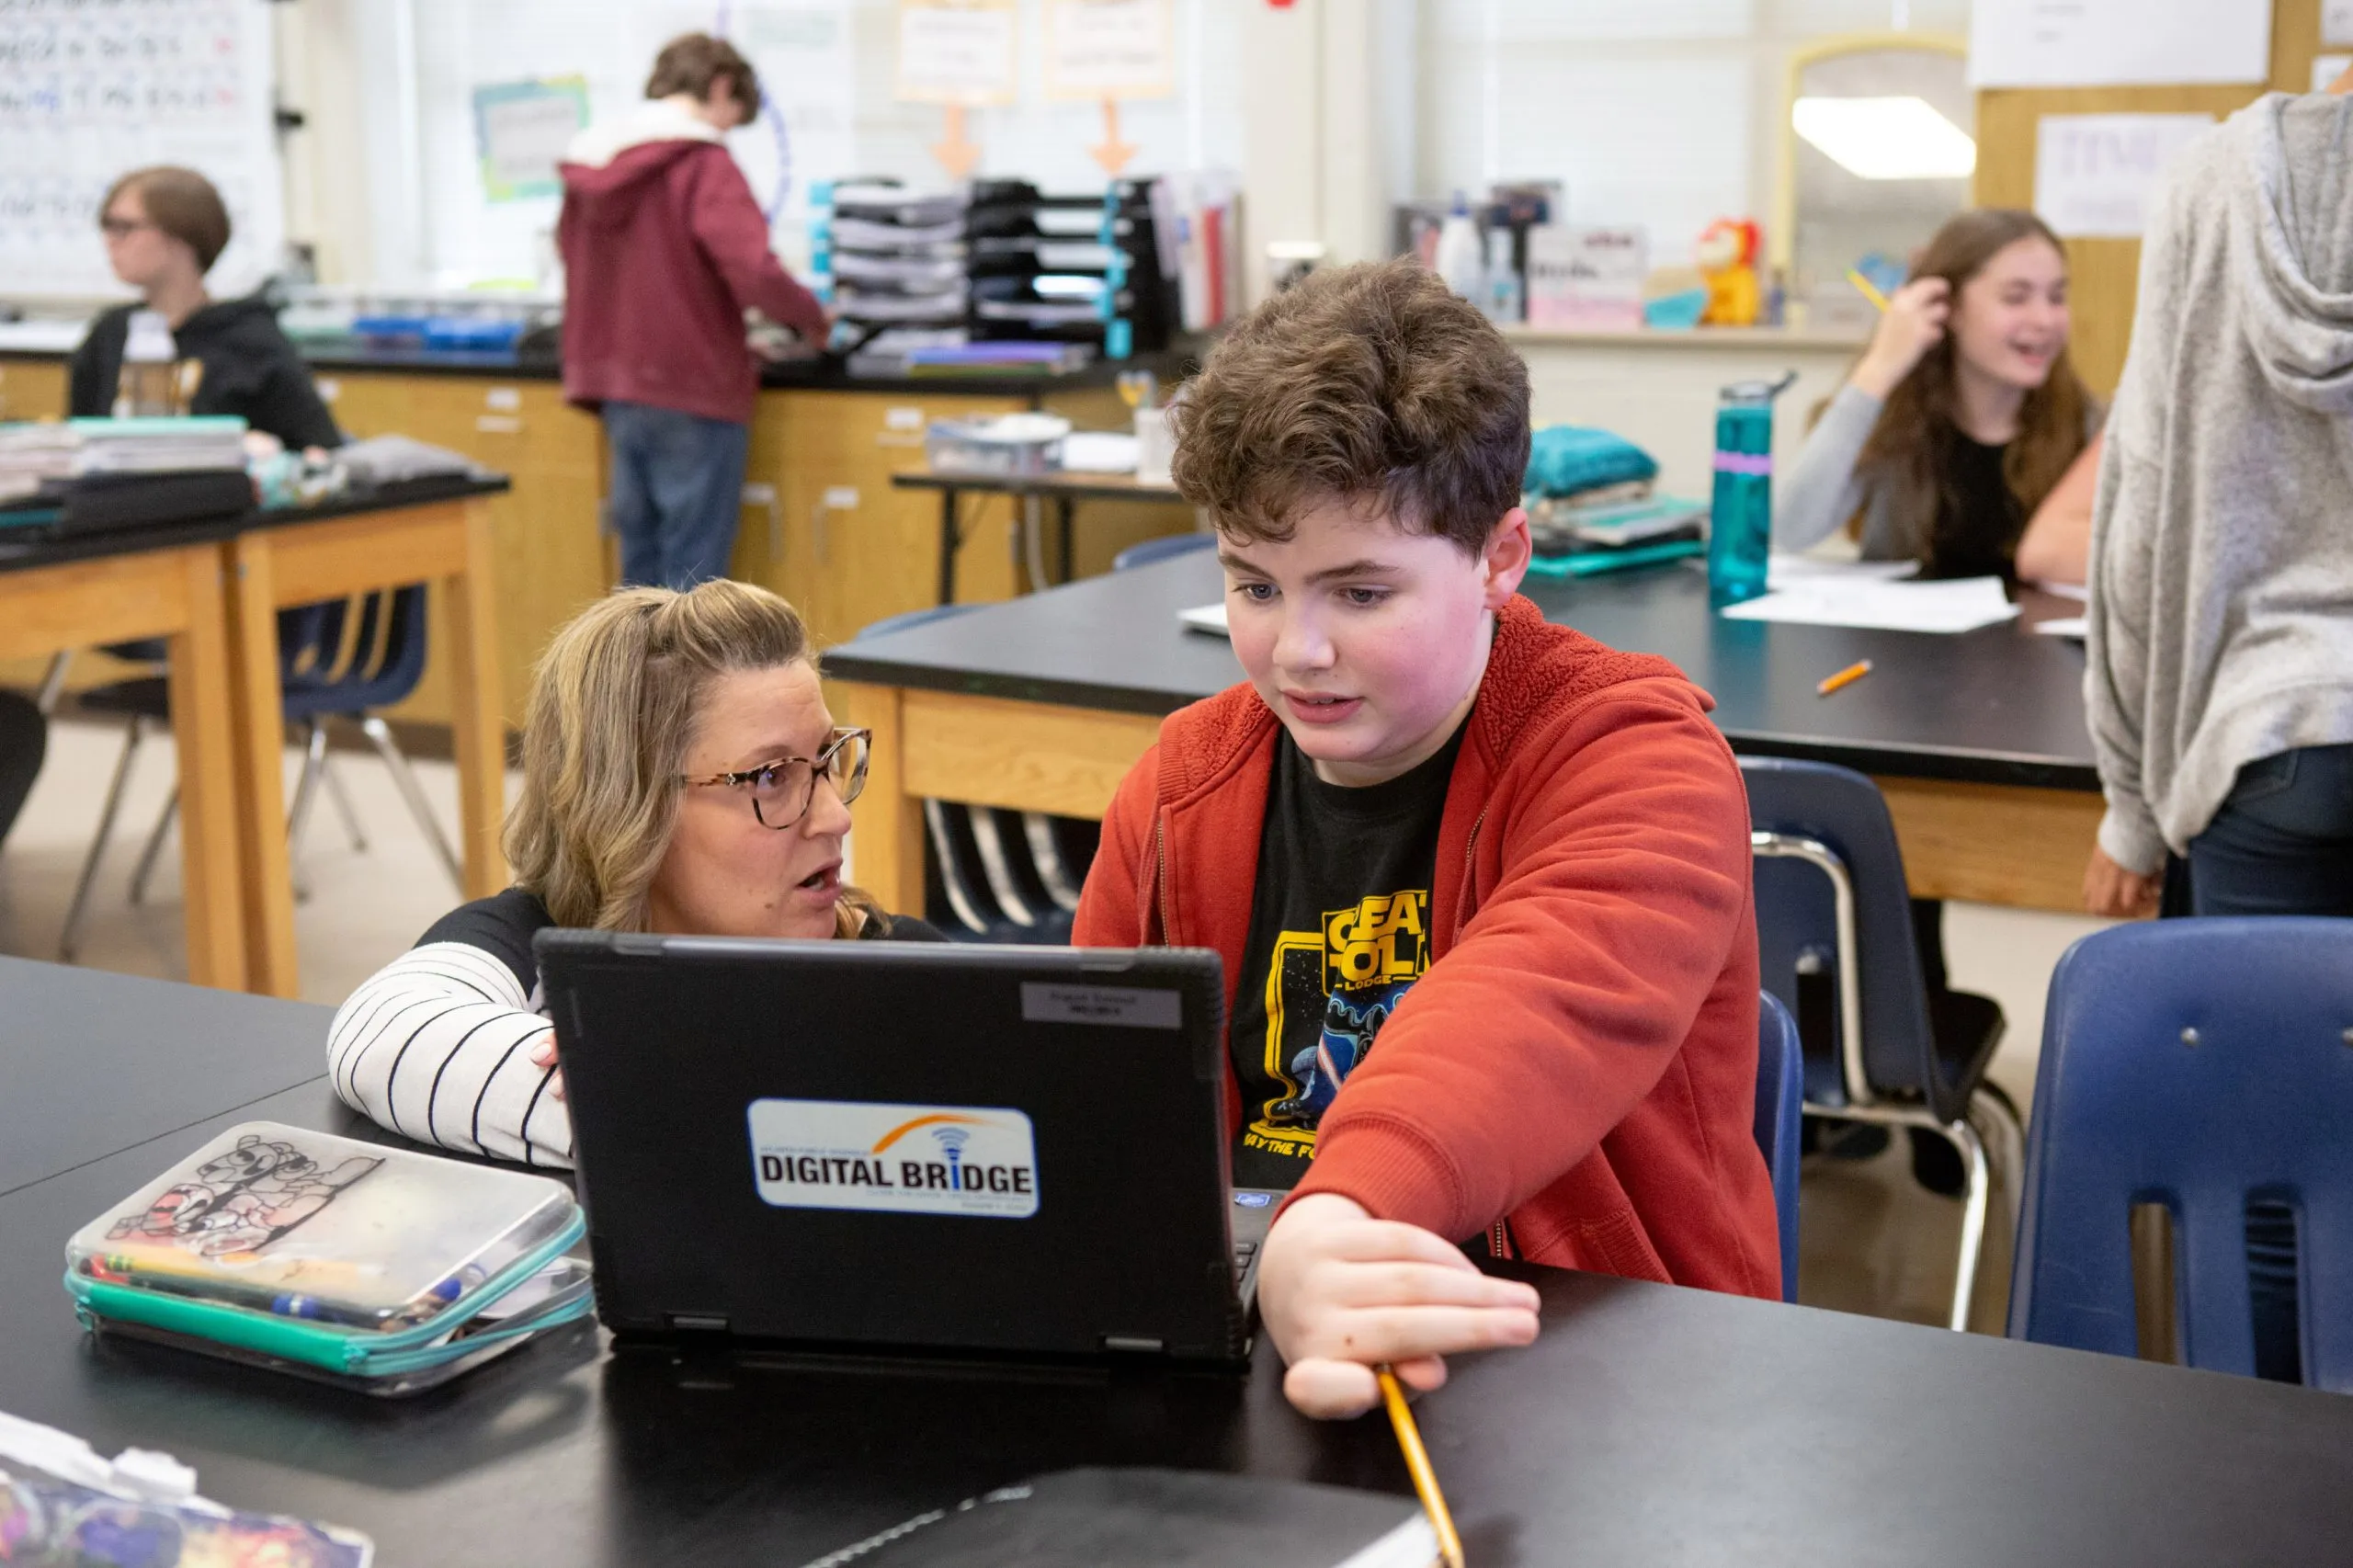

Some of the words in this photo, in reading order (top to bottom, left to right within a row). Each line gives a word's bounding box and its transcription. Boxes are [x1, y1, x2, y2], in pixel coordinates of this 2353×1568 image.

[1345, 975, 1392, 991] LODGE
[1267, 1140, 1296, 1155] THE
[761, 1154, 894, 1187] DIGITAL
